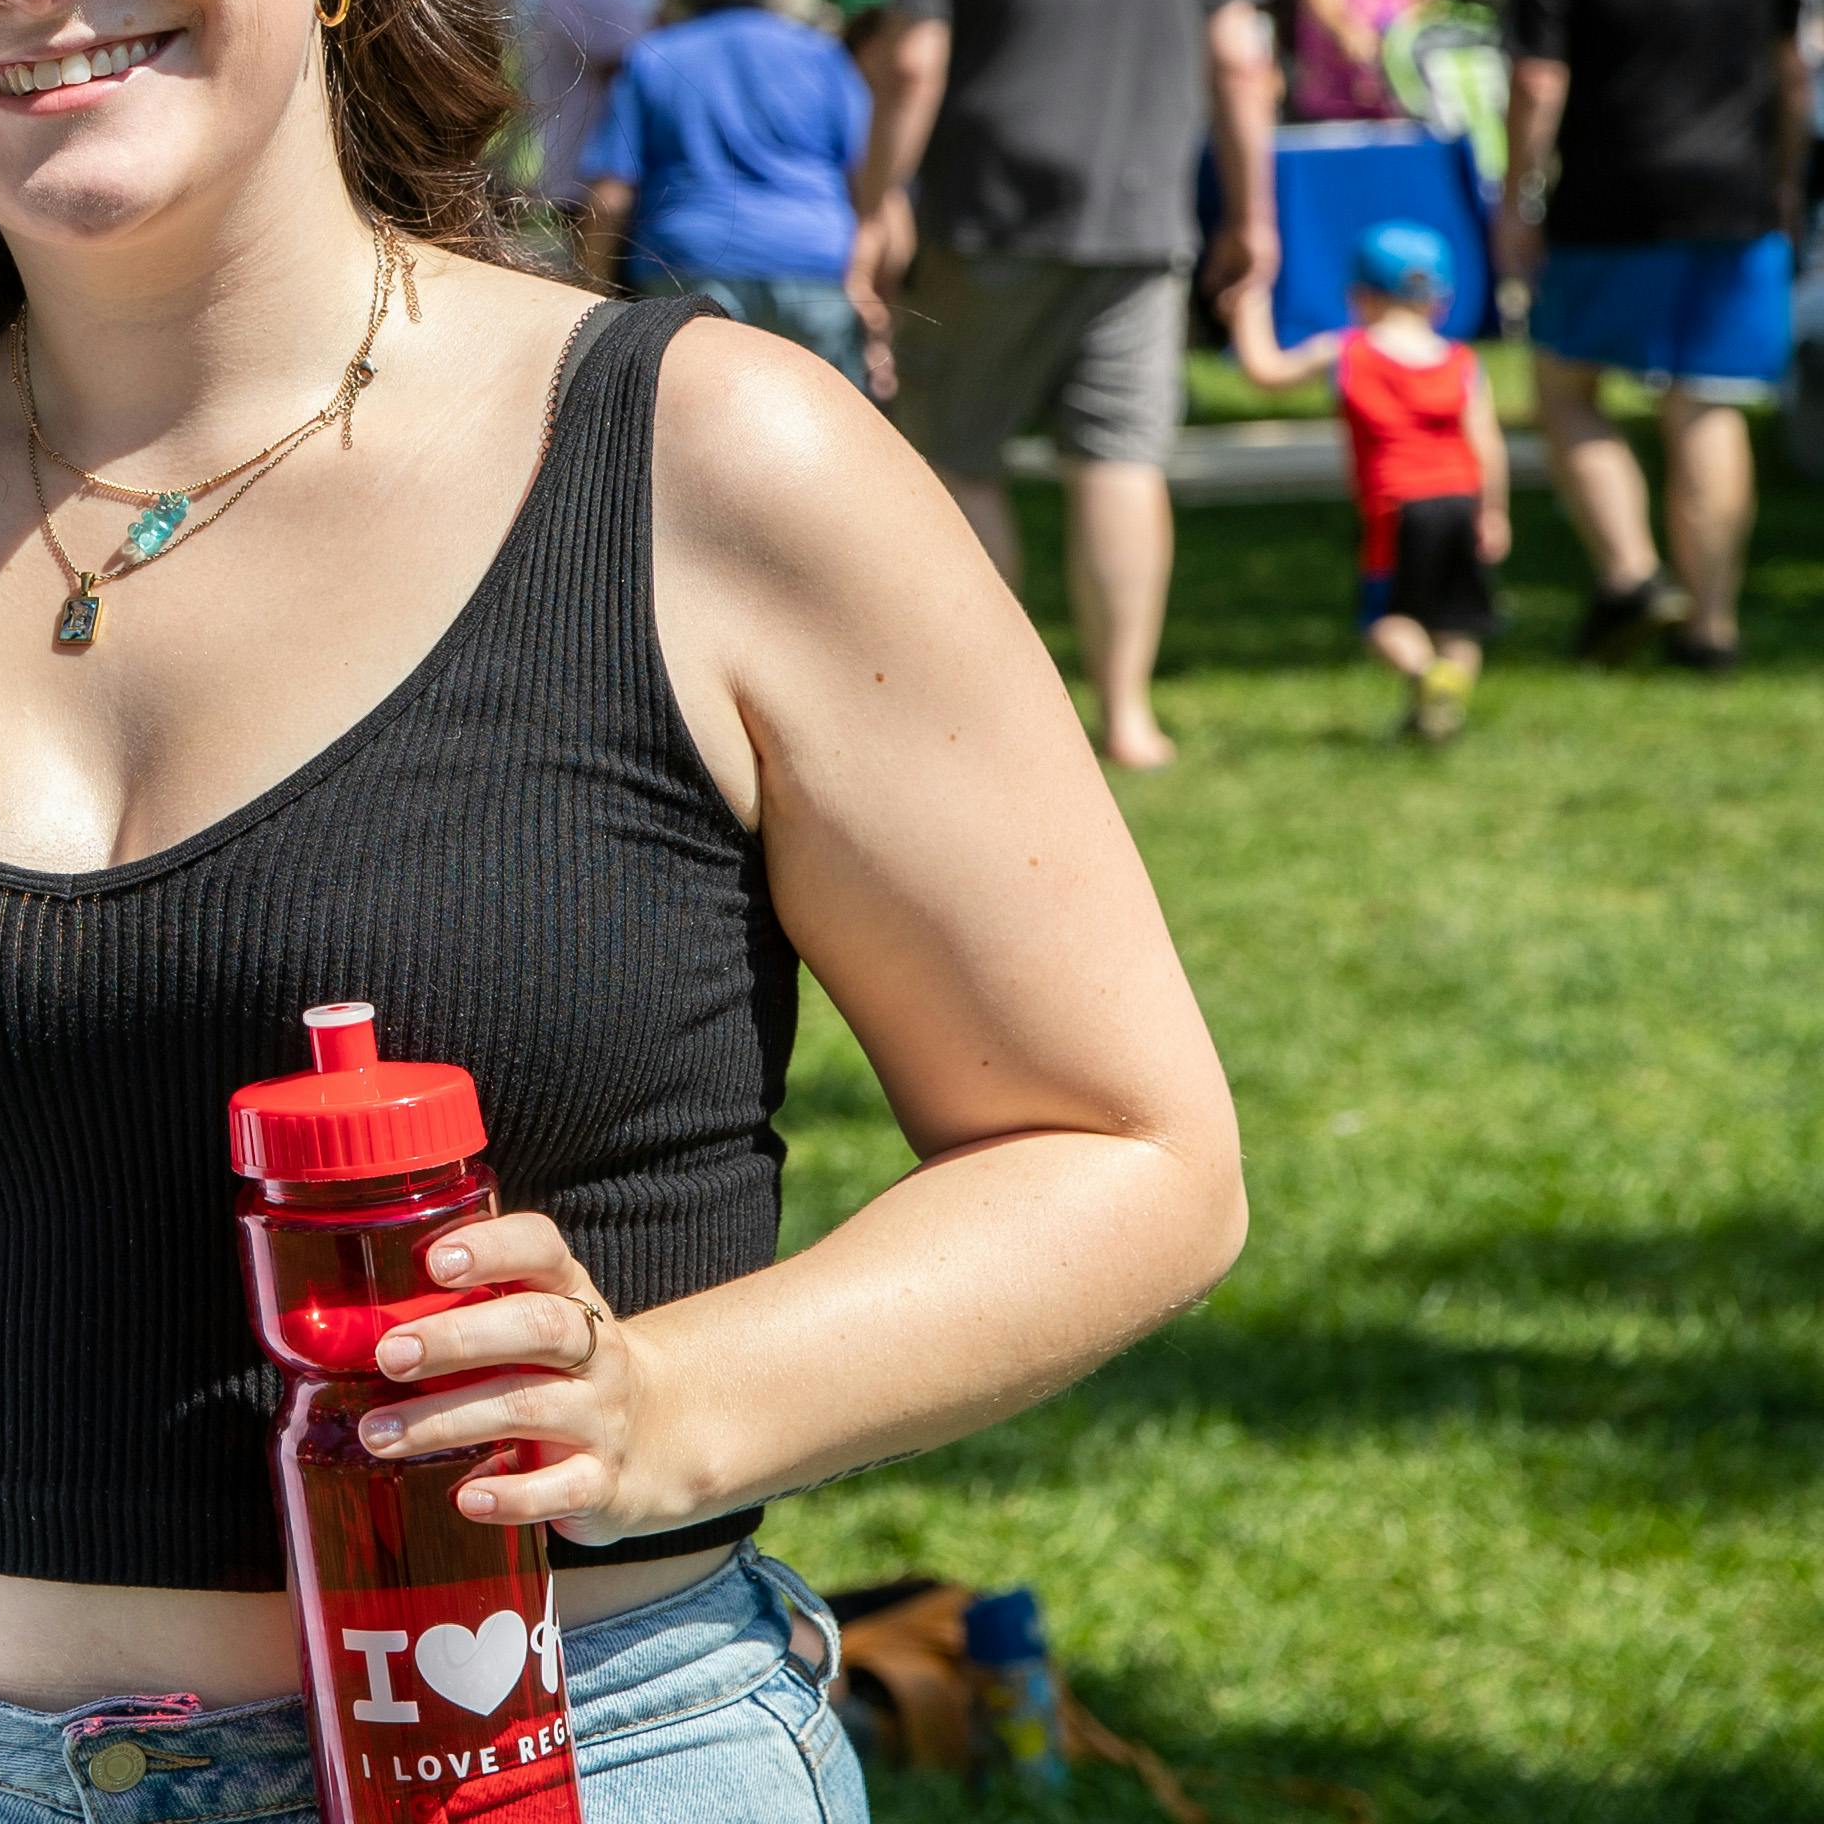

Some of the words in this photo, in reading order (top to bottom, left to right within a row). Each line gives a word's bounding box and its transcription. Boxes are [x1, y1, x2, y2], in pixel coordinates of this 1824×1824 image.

[342, 1628, 420, 1723] I
[362, 1753, 371, 1778] I
[393, 1746, 501, 1782] LOVE
